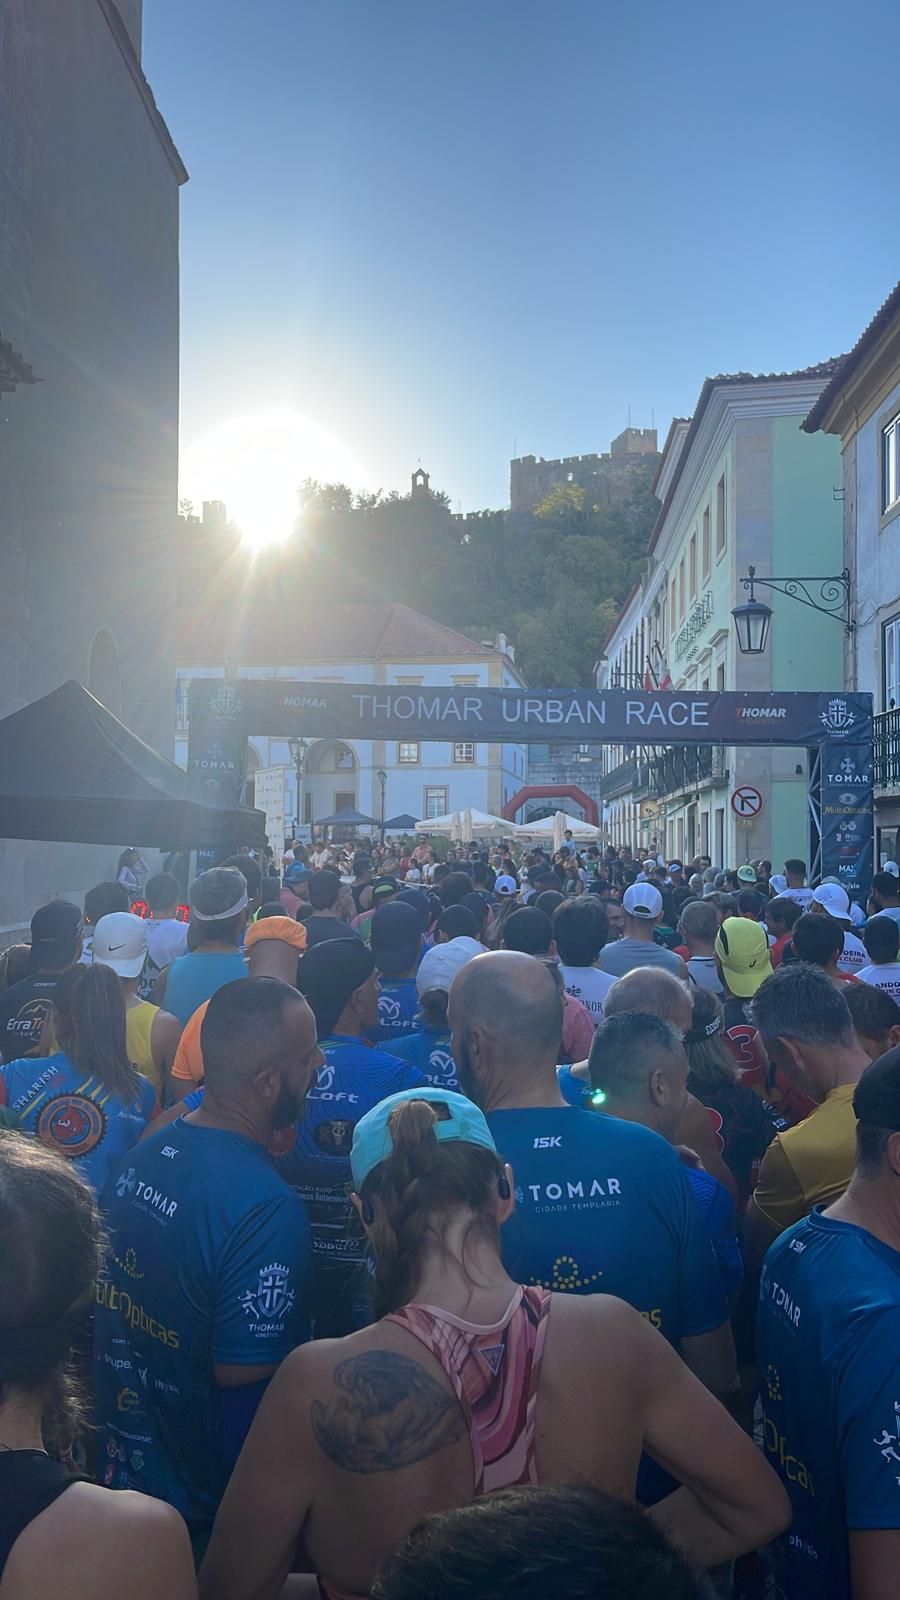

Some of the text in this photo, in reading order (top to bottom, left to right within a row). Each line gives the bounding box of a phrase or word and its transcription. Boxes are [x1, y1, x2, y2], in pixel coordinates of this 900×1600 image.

[281, 697, 328, 708] HOMAR
[352, 694, 709, 726] THOMAR URBAN RACE
[736, 707, 787, 718] THOMAR
[193, 760, 234, 769] TOMAR
[827, 774, 869, 783] TOMAR
[842, 950, 866, 958] OEIRA
[7, 1017, 46, 1031] ErraTr
[380, 1018, 421, 1030] Loft
[12, 1065, 60, 1112] SHARISH
[305, 1091, 360, 1104] Loft
[533, 1136, 562, 1149] 15K
[529, 1178, 622, 1202] TOMAR
[136, 1181, 178, 1218] TOMAR
[535, 1200, 621, 1214] CIDADE TEMPLARIA
[772, 1282, 801, 1328] TOMAR
[247, 1323, 285, 1332] THOMAR
